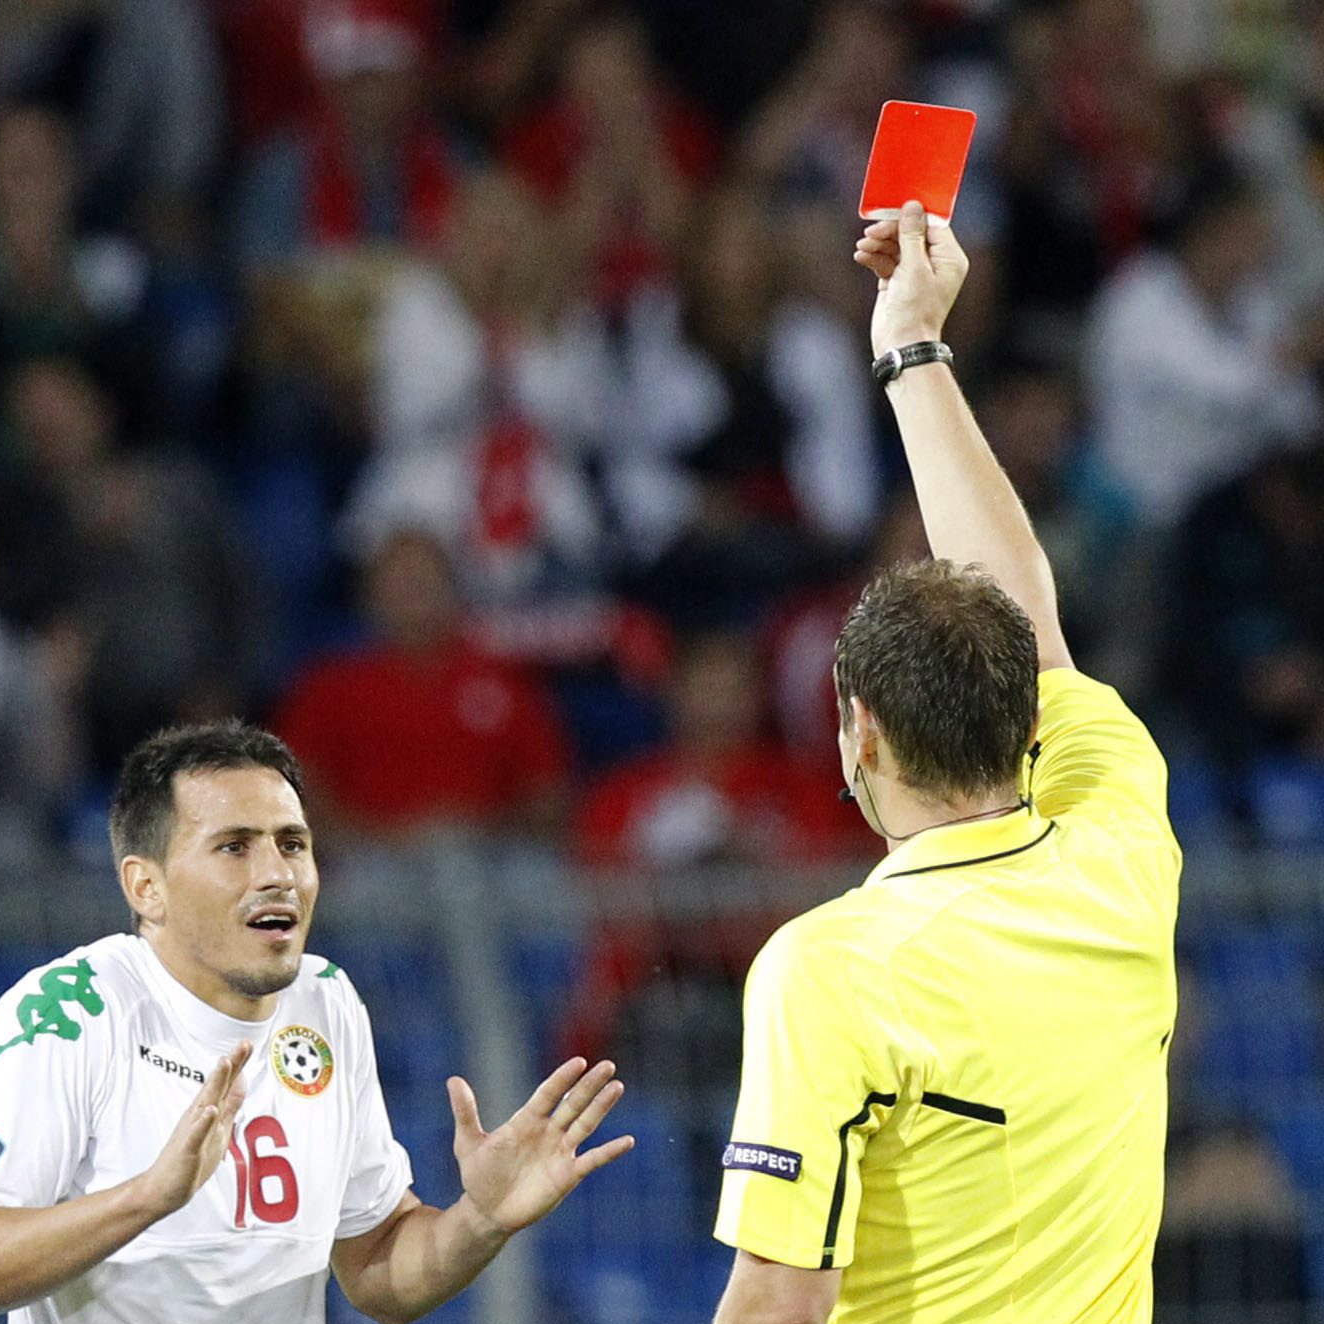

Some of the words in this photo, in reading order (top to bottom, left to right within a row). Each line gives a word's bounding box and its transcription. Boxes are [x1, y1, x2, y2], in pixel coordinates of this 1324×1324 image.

[139, 1045, 205, 1084] Kappa
[228, 1115, 299, 1228] 16
[734, 1147, 798, 1173] RESPECT
